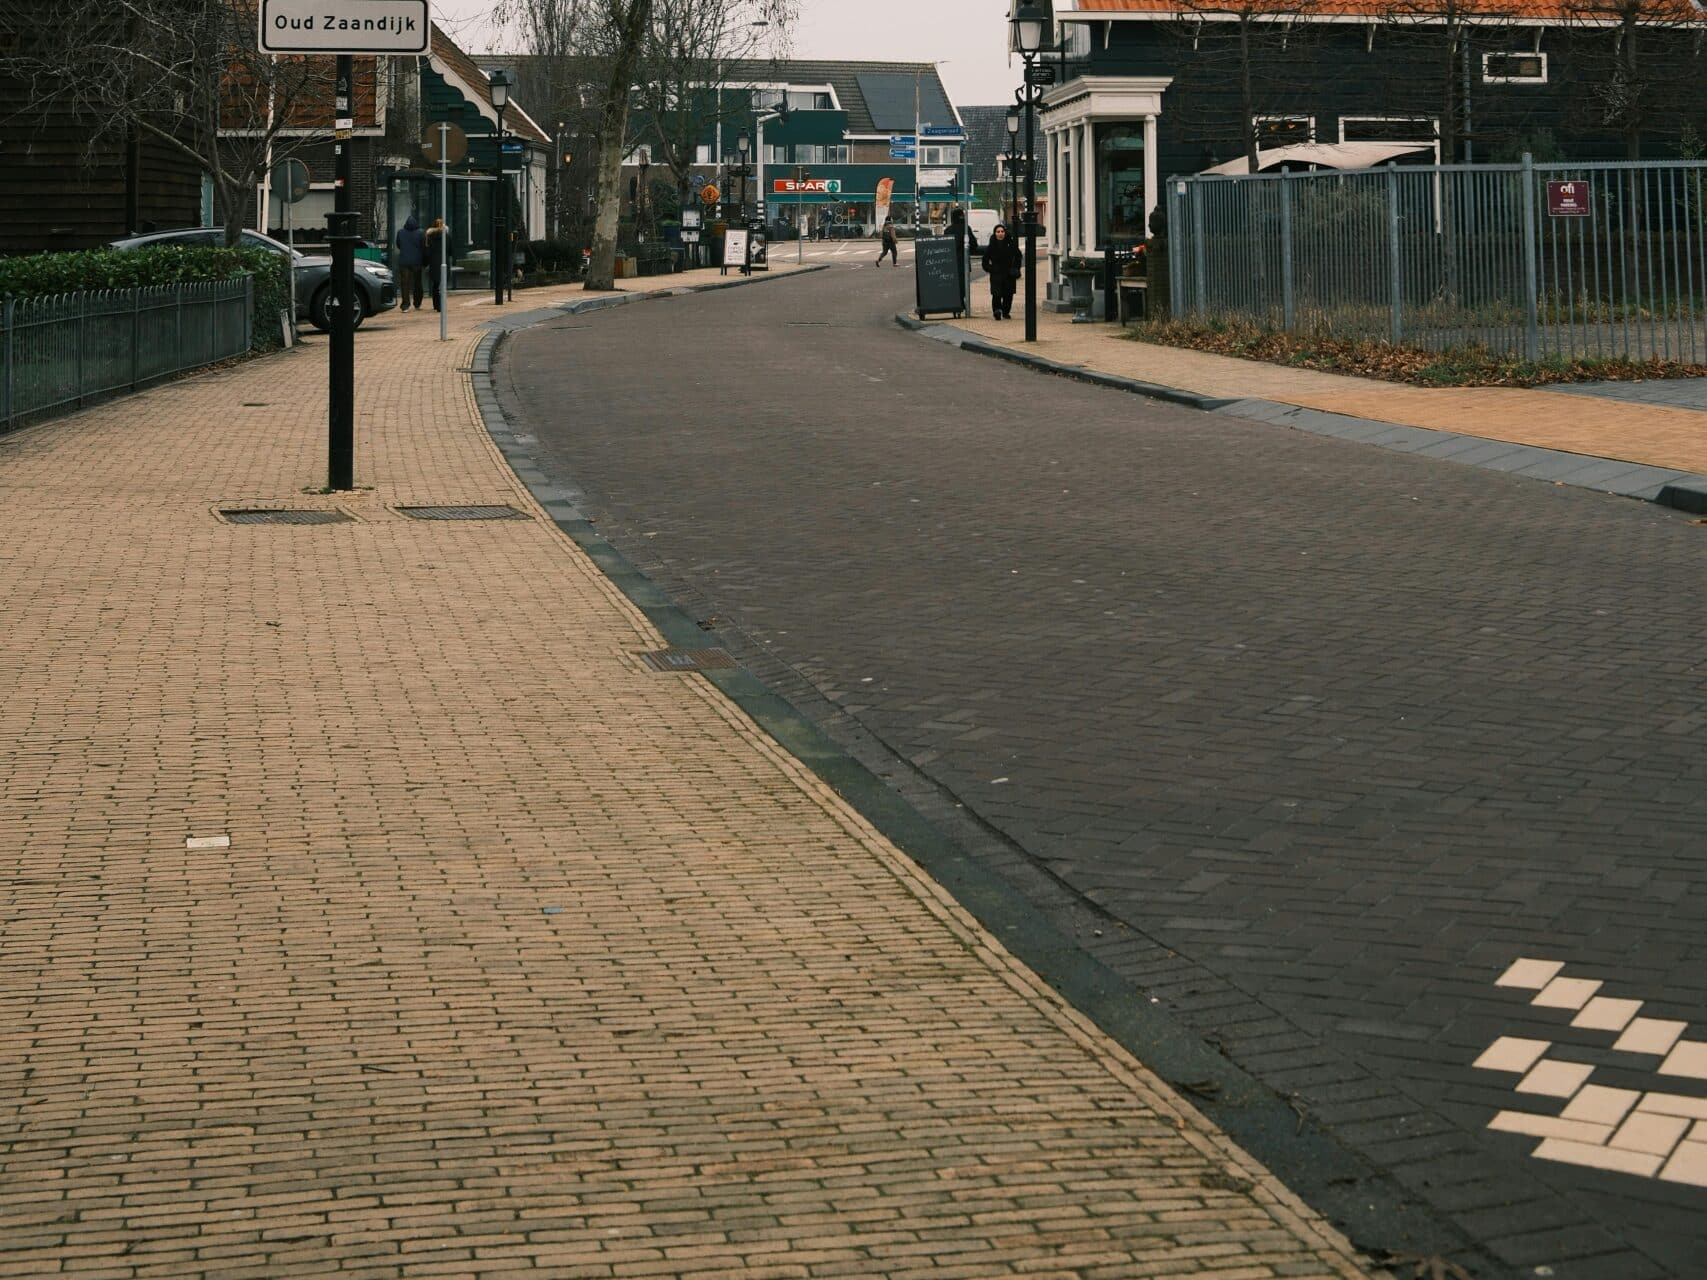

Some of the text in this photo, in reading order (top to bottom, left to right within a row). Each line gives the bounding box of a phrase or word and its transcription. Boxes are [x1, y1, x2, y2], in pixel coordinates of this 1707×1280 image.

[275, 15, 415, 35] Oud Zaandijk
[785, 182, 825, 191] SPAR
